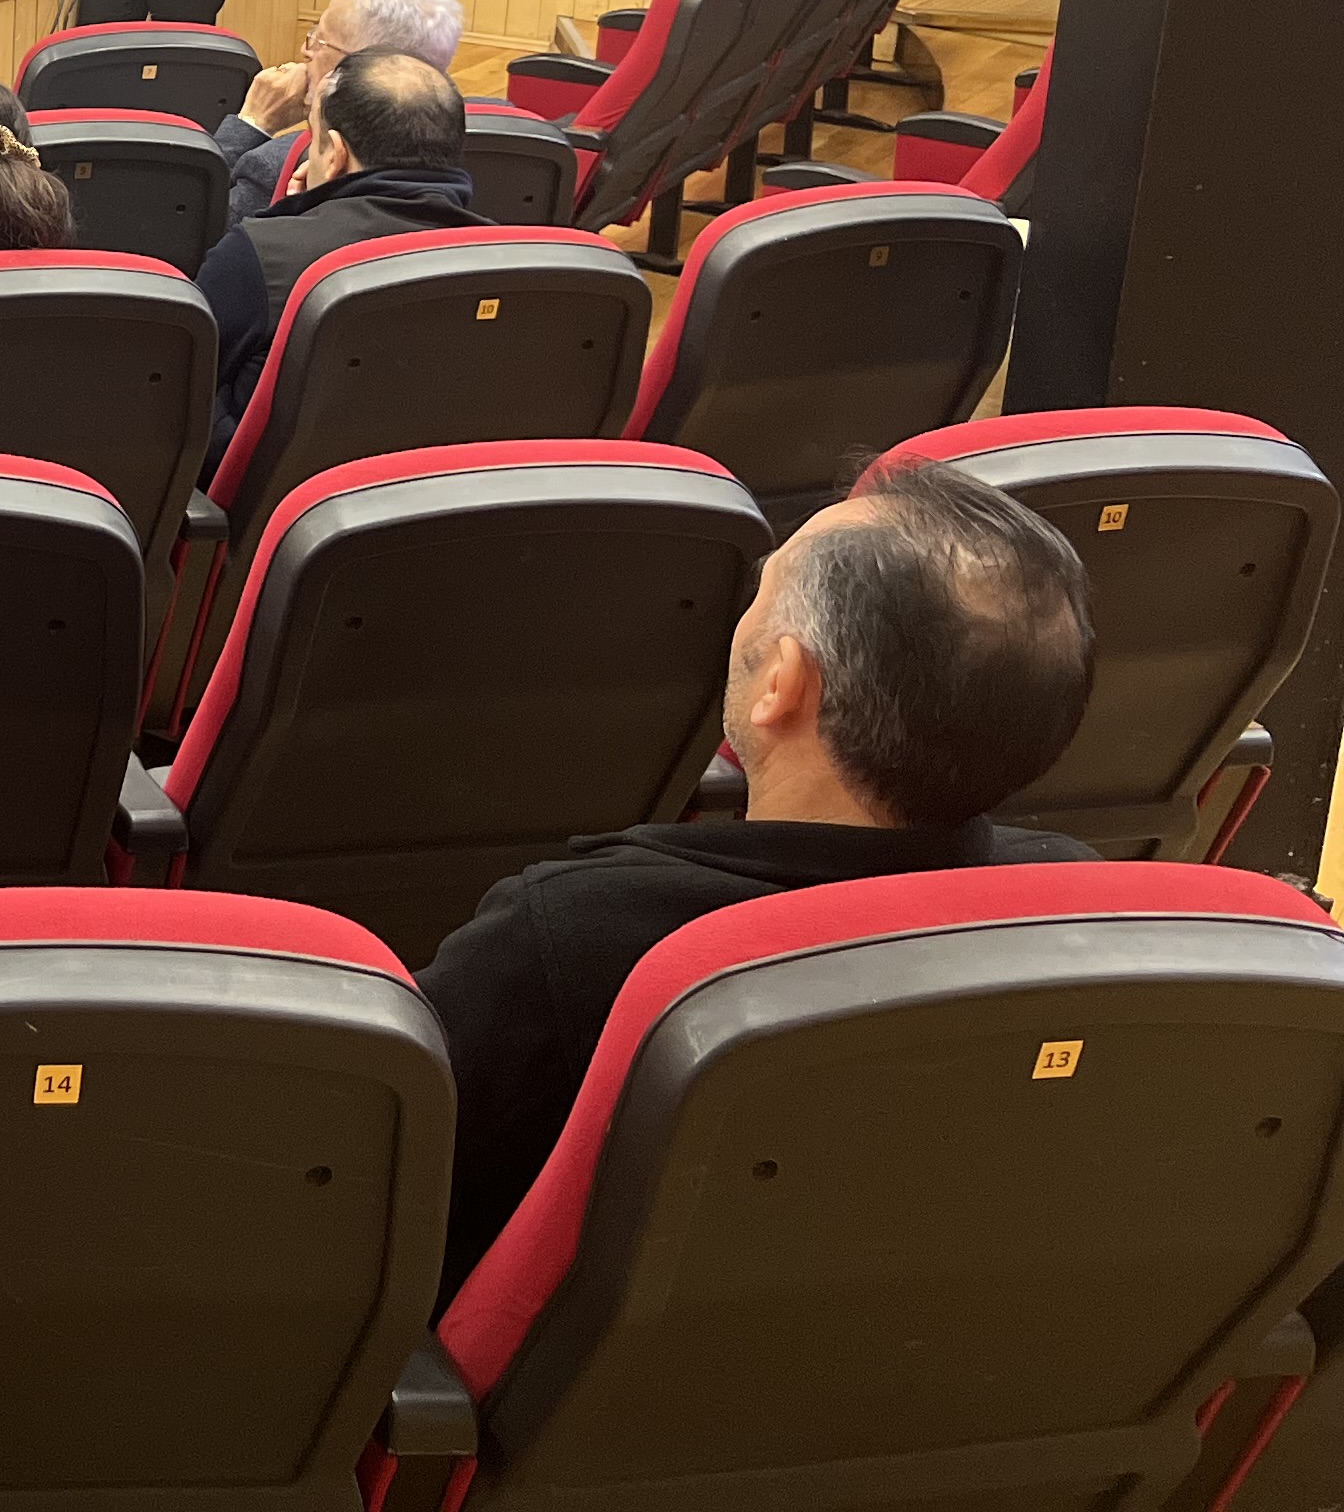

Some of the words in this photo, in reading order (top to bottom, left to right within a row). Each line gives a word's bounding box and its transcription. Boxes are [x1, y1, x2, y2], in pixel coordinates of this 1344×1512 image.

[480, 304, 495, 315] 10
[1104, 511, 1122, 523] 10
[1042, 1051, 1072, 1069] 13
[42, 1075, 72, 1093] 14
